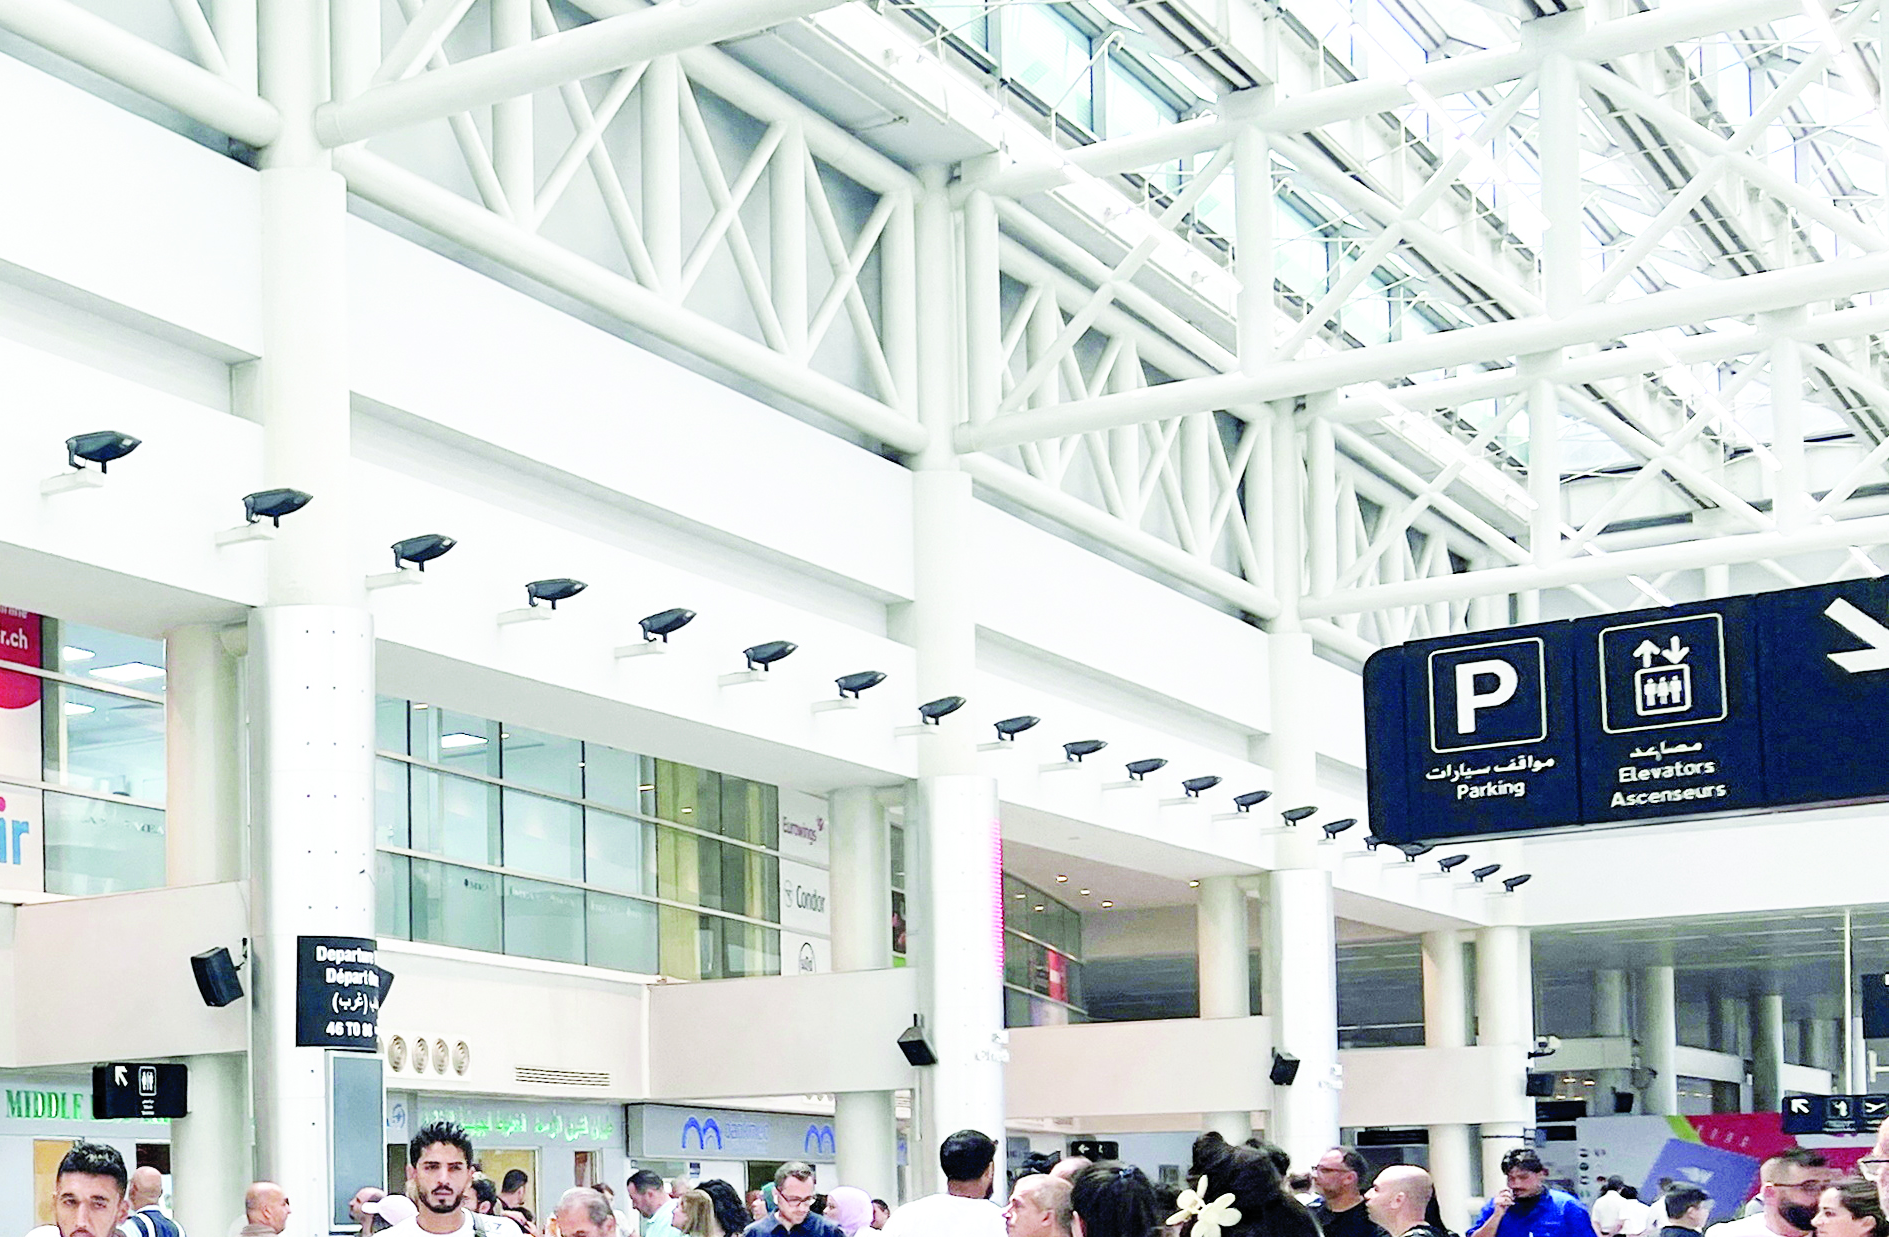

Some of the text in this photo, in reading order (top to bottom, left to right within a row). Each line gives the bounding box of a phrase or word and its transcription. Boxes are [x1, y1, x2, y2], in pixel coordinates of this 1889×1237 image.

[1455, 658, 1519, 734] P
[1629, 740, 1703, 761] مصاعد
[1425, 754, 1555, 783] مواقف سيارات
[1618, 758, 1716, 784] Elevators
[1456, 779, 1526, 800] Parking
[1610, 782, 1727, 808] Ascenseurs
[796, 885, 826, 914] Condor
[325, 967, 369, 988] Départ
[331, 991, 369, 1016] (غرب)
[325, 1021, 345, 1037] 46
[345, 1021, 362, 1037] TO
[5, 1089, 84, 1120] MIDDLE
